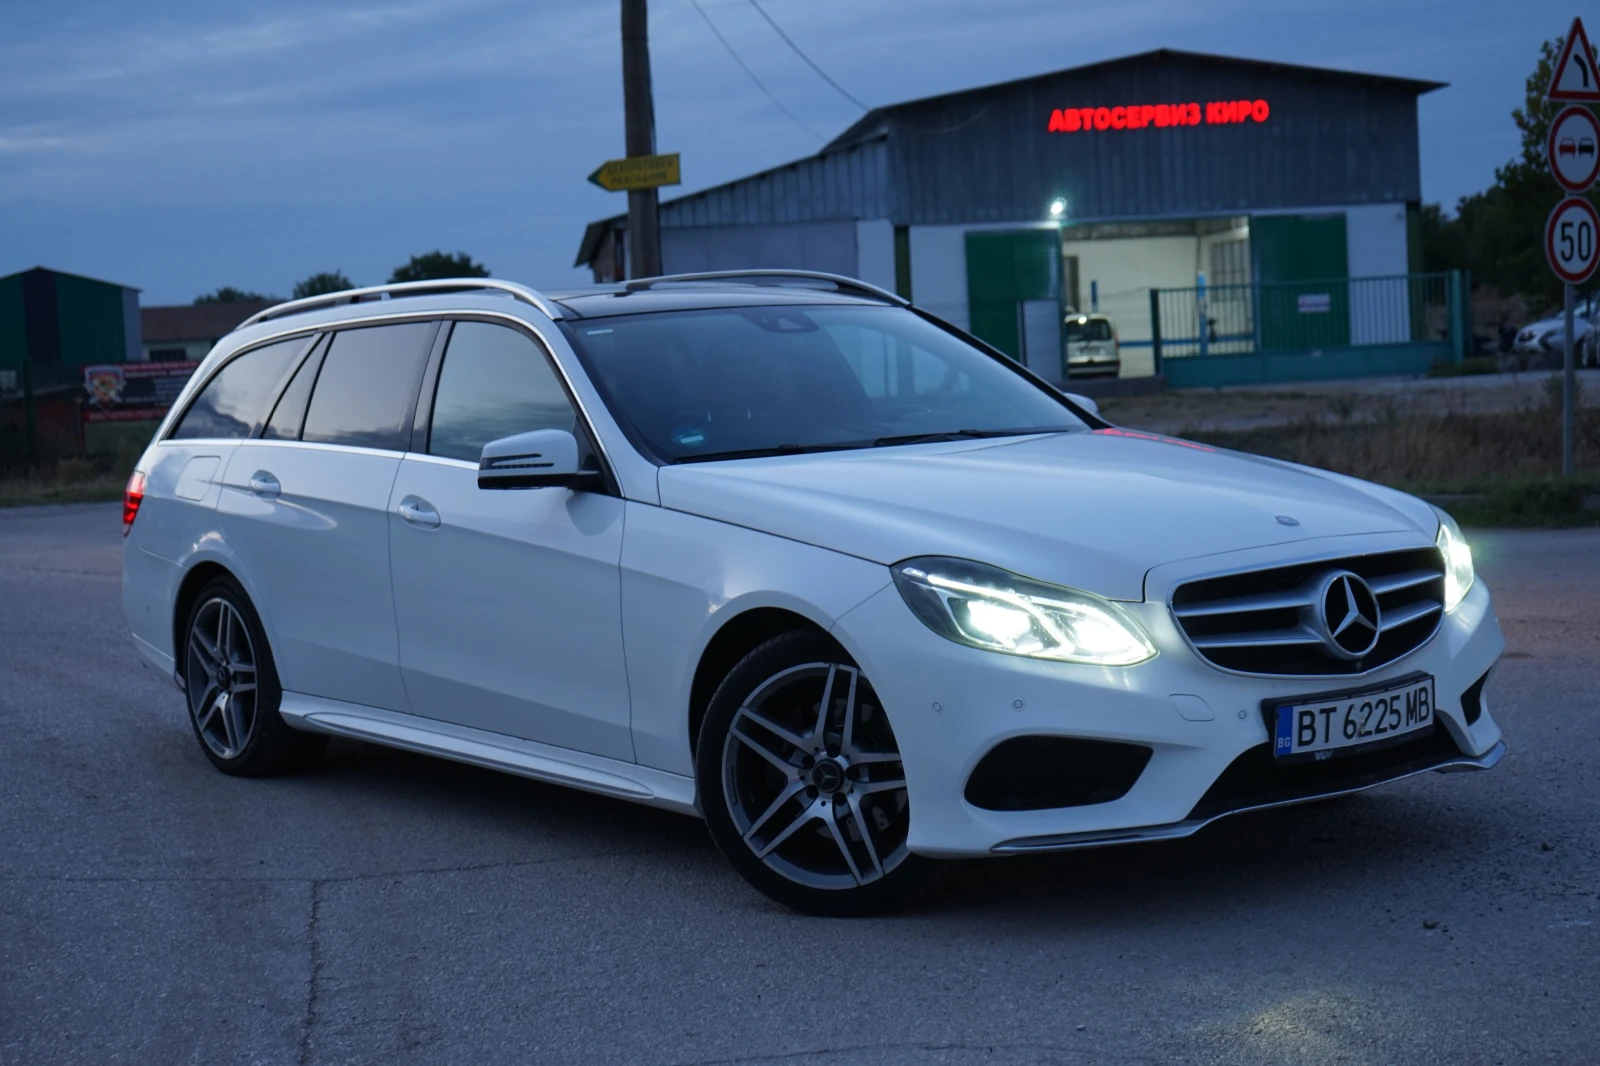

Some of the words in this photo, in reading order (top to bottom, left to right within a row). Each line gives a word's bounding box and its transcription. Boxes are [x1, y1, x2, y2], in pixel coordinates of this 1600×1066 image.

[1047, 103, 1202, 132] АВТОСЕРВИЗ
[1205, 99, 1269, 124] КИРО
[1561, 222, 1591, 261] 50
[1297, 706, 1338, 747] BT
[1343, 695, 1402, 740] 6225
[1406, 686, 1430, 727] MB
[1277, 737, 1291, 749] BG
